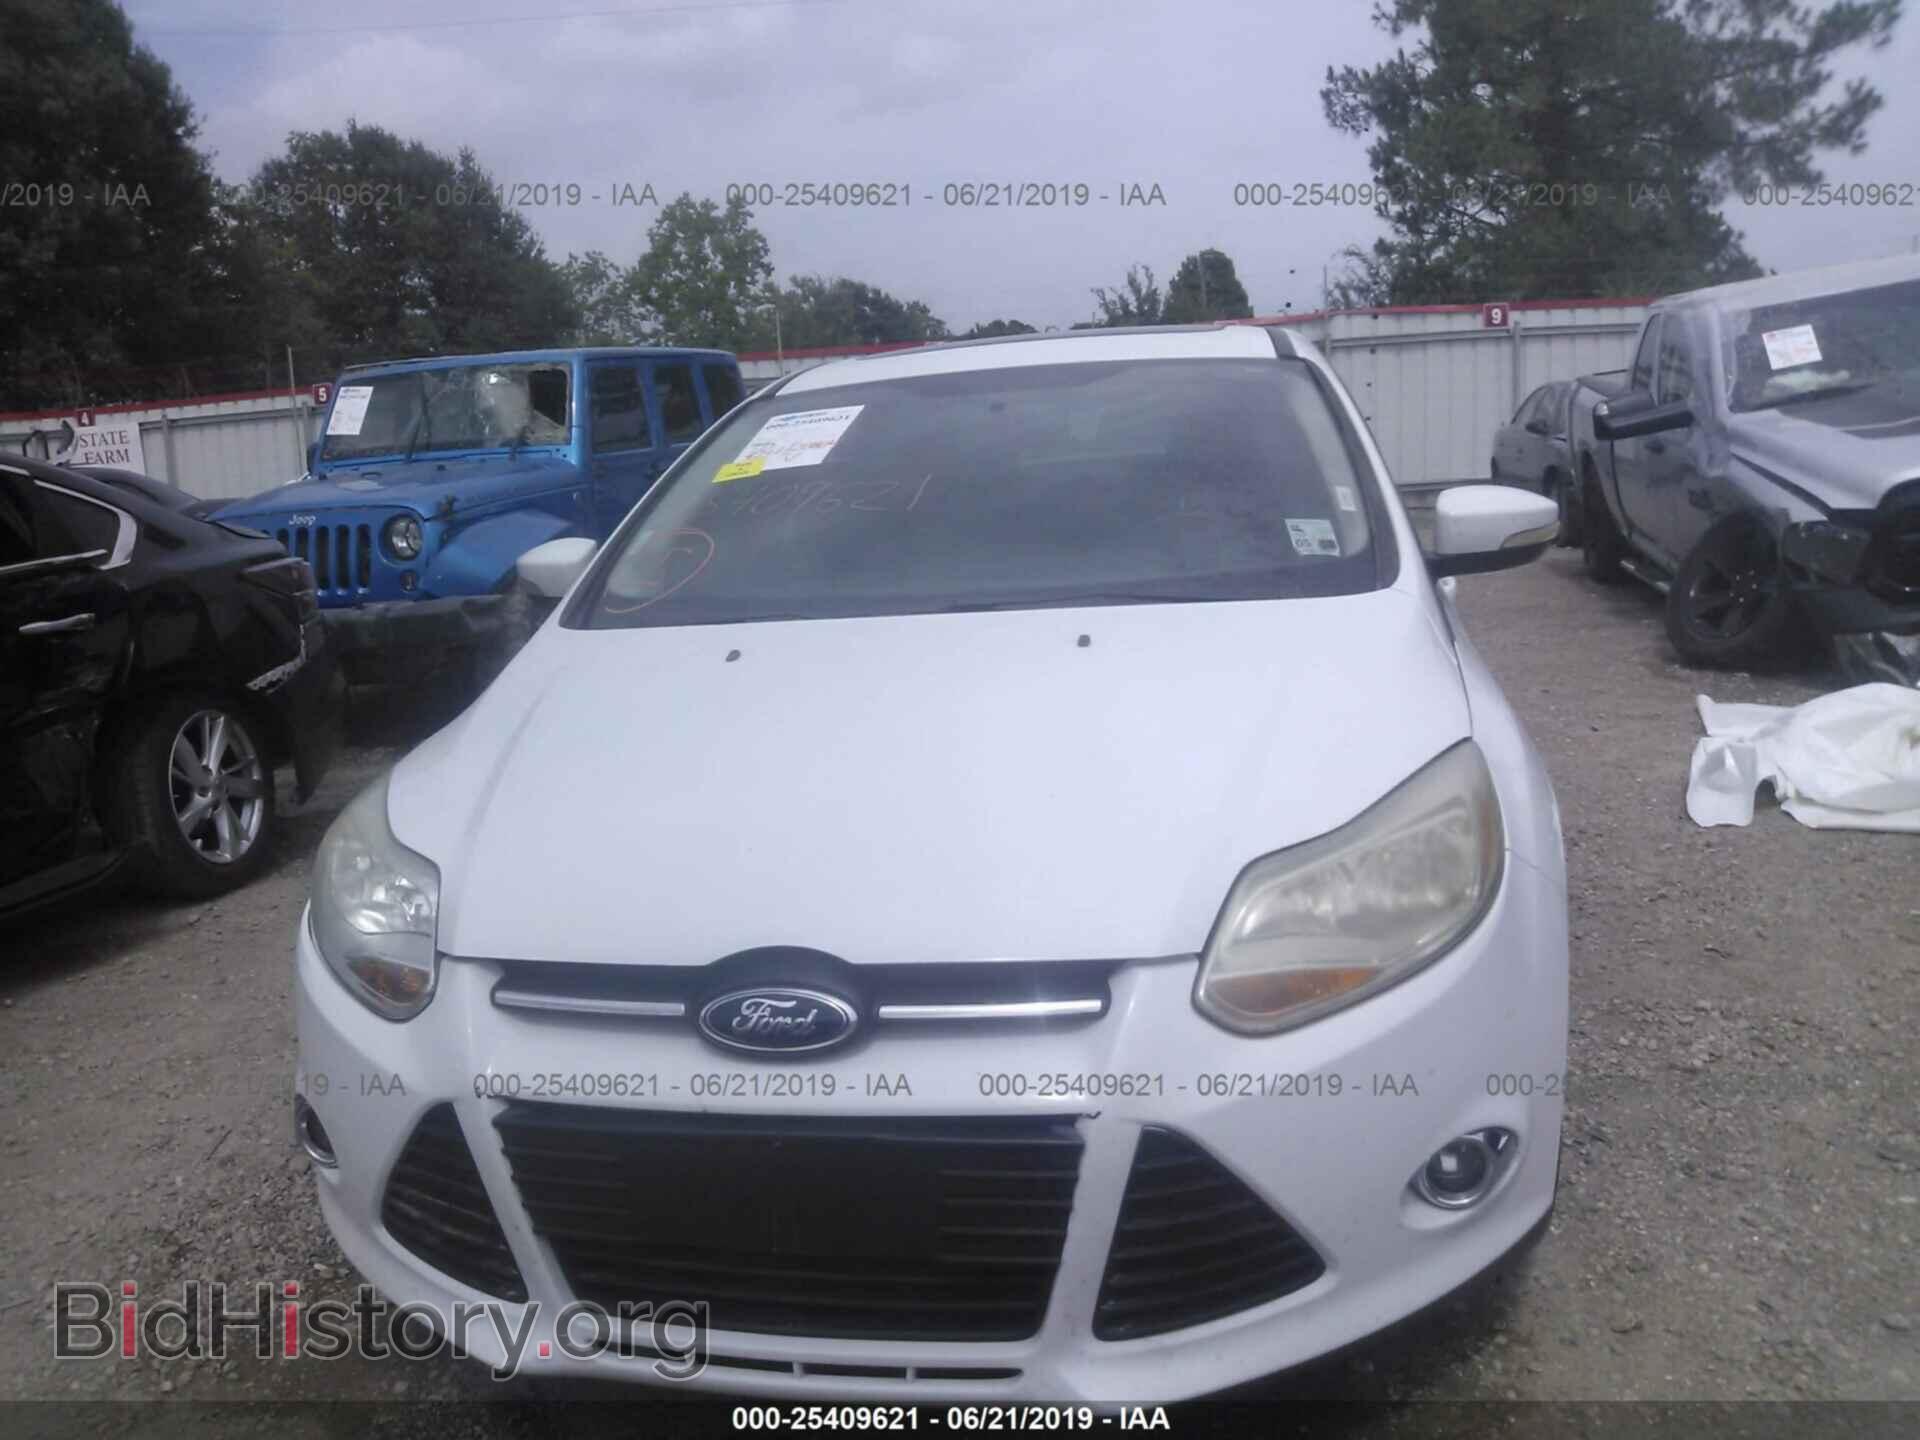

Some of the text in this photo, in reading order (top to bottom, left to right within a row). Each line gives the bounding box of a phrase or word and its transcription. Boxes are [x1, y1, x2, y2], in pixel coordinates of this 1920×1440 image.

[1491, 308, 1502, 324] 9
[319, 387, 327, 401] 5
[80, 430, 129, 448] STATE
[84, 448, 130, 464] FARM
[288, 514, 317, 526] Jeep
[732, 997, 819, 1034] Ford
